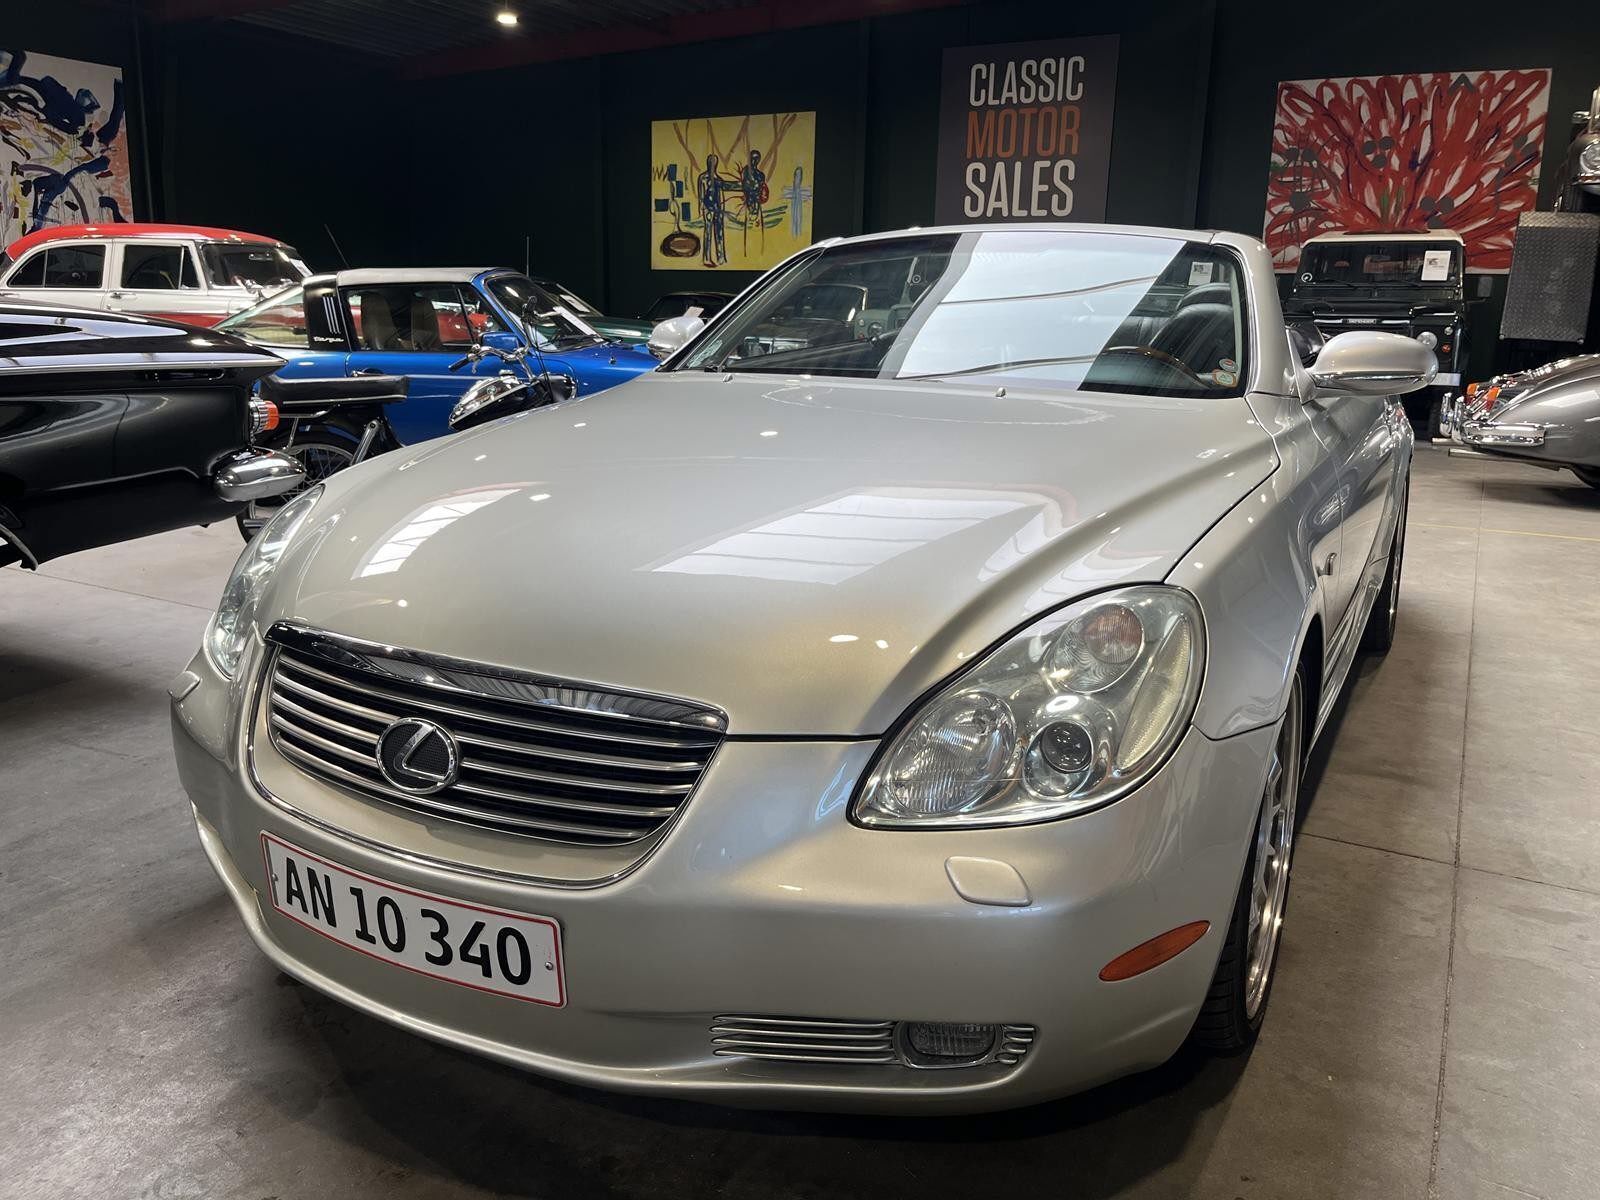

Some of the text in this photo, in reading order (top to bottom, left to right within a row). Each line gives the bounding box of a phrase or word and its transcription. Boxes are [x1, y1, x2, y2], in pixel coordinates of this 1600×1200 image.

[969, 56, 1085, 106] CLASSIC
[966, 105, 1081, 159] MOTOR
[964, 159, 1076, 218] SALES
[286, 857, 532, 985] AN 10 340
